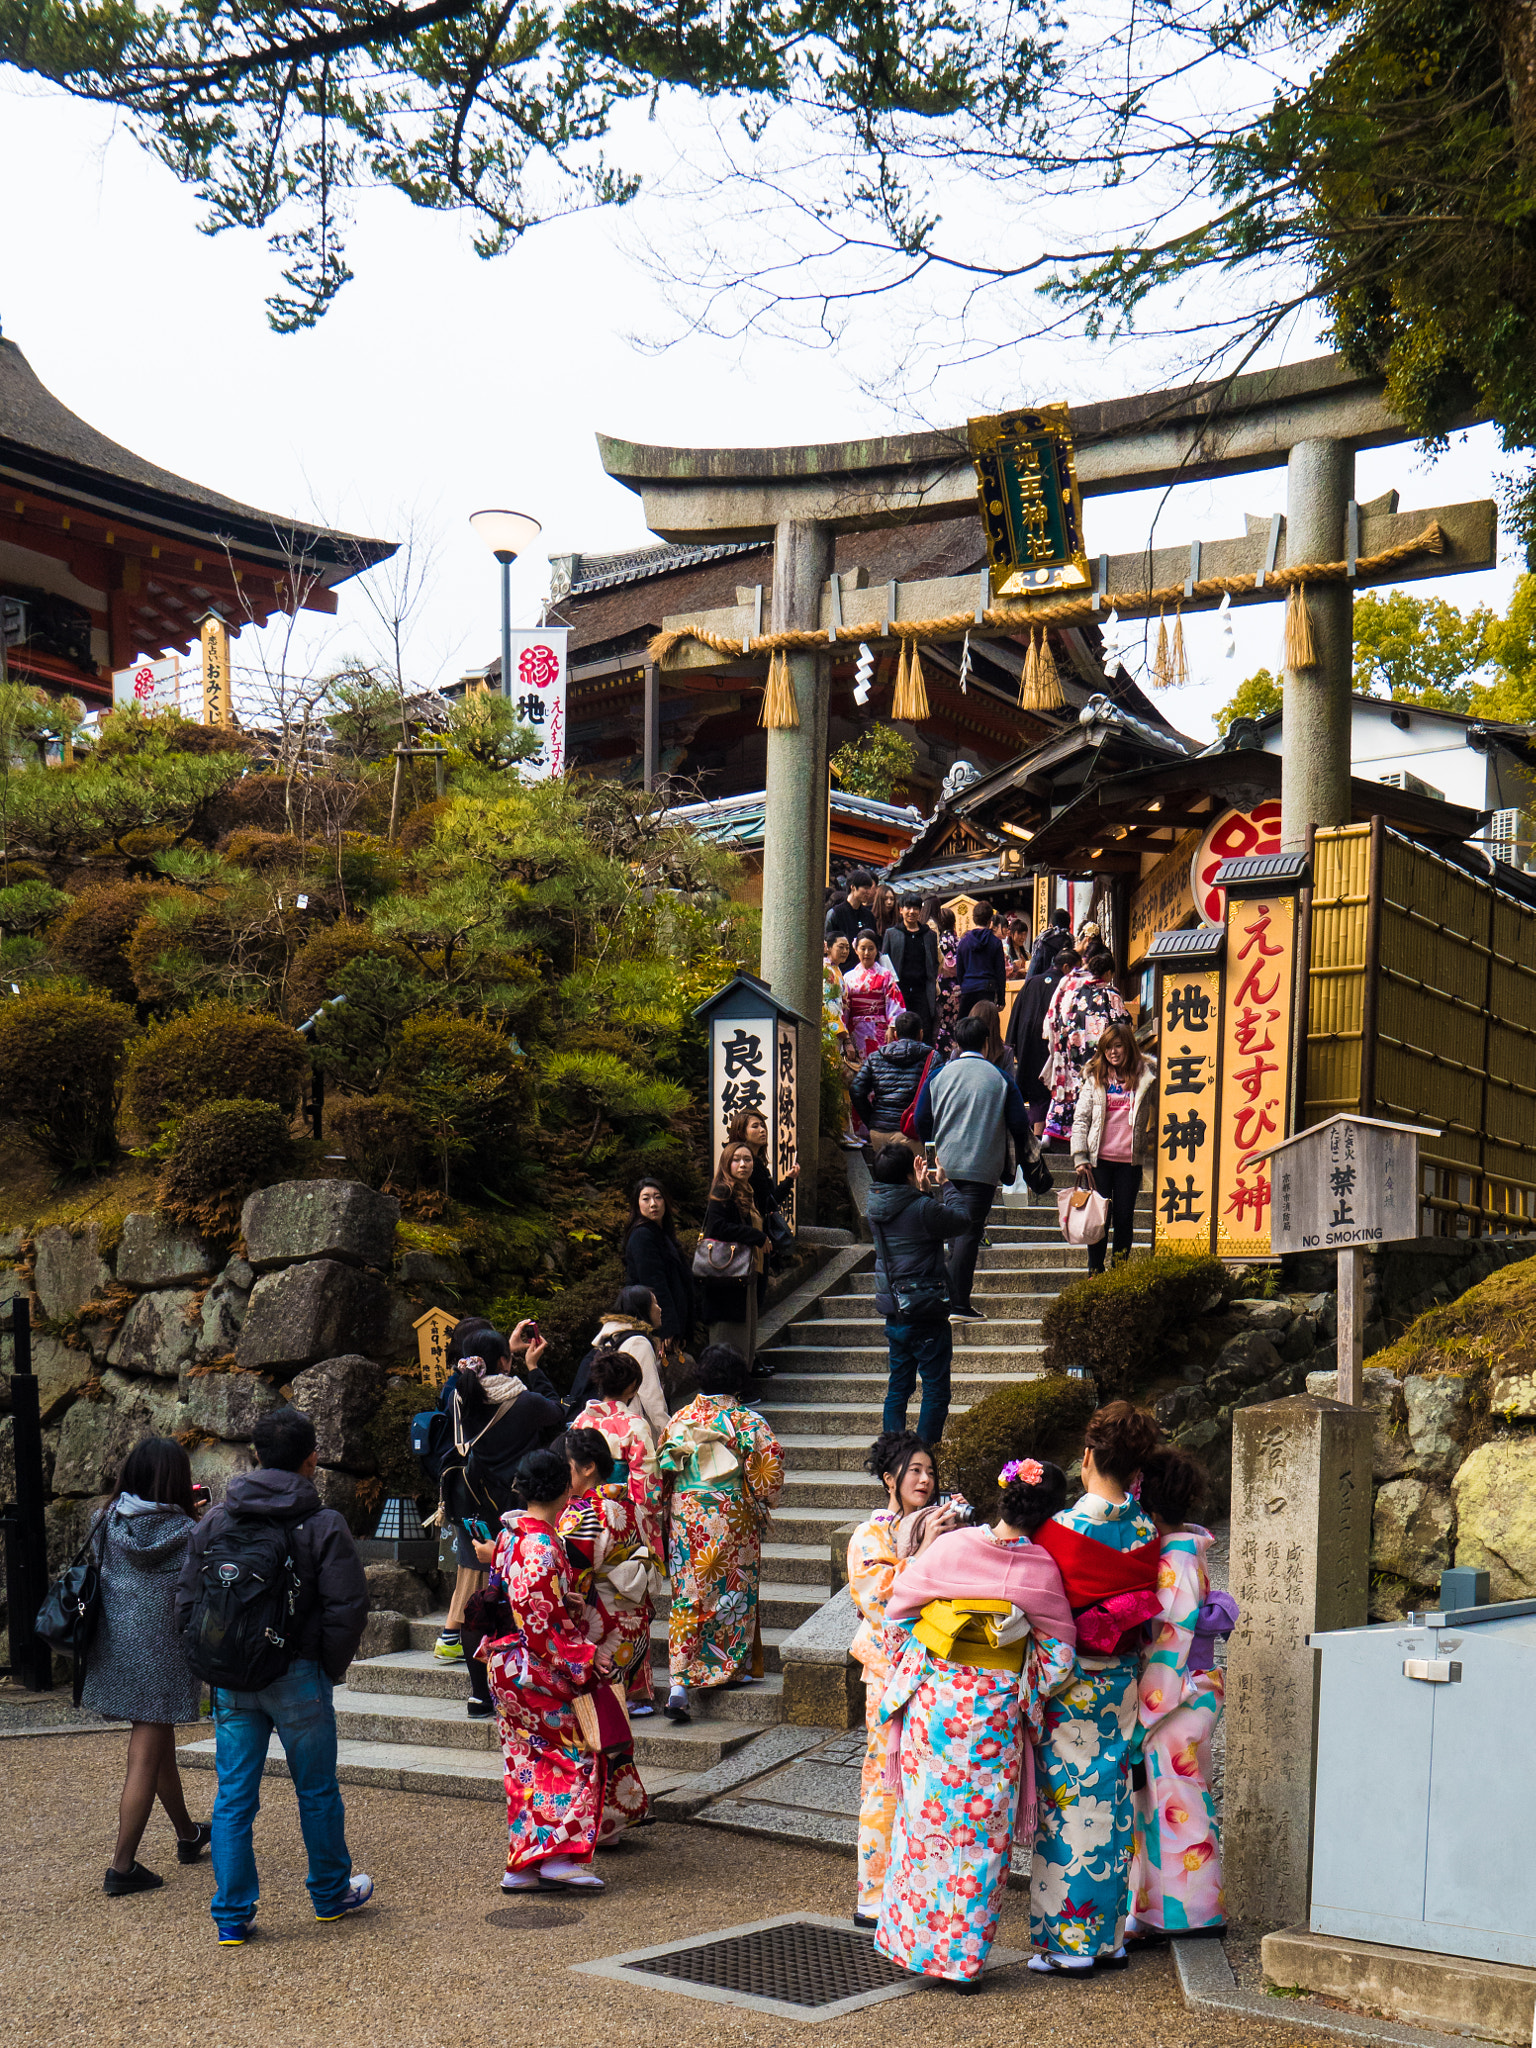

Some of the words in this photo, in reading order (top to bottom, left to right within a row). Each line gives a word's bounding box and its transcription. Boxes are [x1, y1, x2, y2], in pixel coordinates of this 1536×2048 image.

[518, 644, 560, 688] 縁
[1223, 905, 1284, 1234] えんむすびの神
[1160, 983, 1208, 1224] 地主神社
[1330, 1127, 1341, 1163] たばこ
[1344, 1125, 1356, 1161] たき火
[1281, 1172, 1292, 1232] 京都市消防局
[1329, 1165, 1357, 1228] 禁止
[1302, 1234, 1320, 1248] NO
[1325, 1227, 1383, 1245] SMOKING
